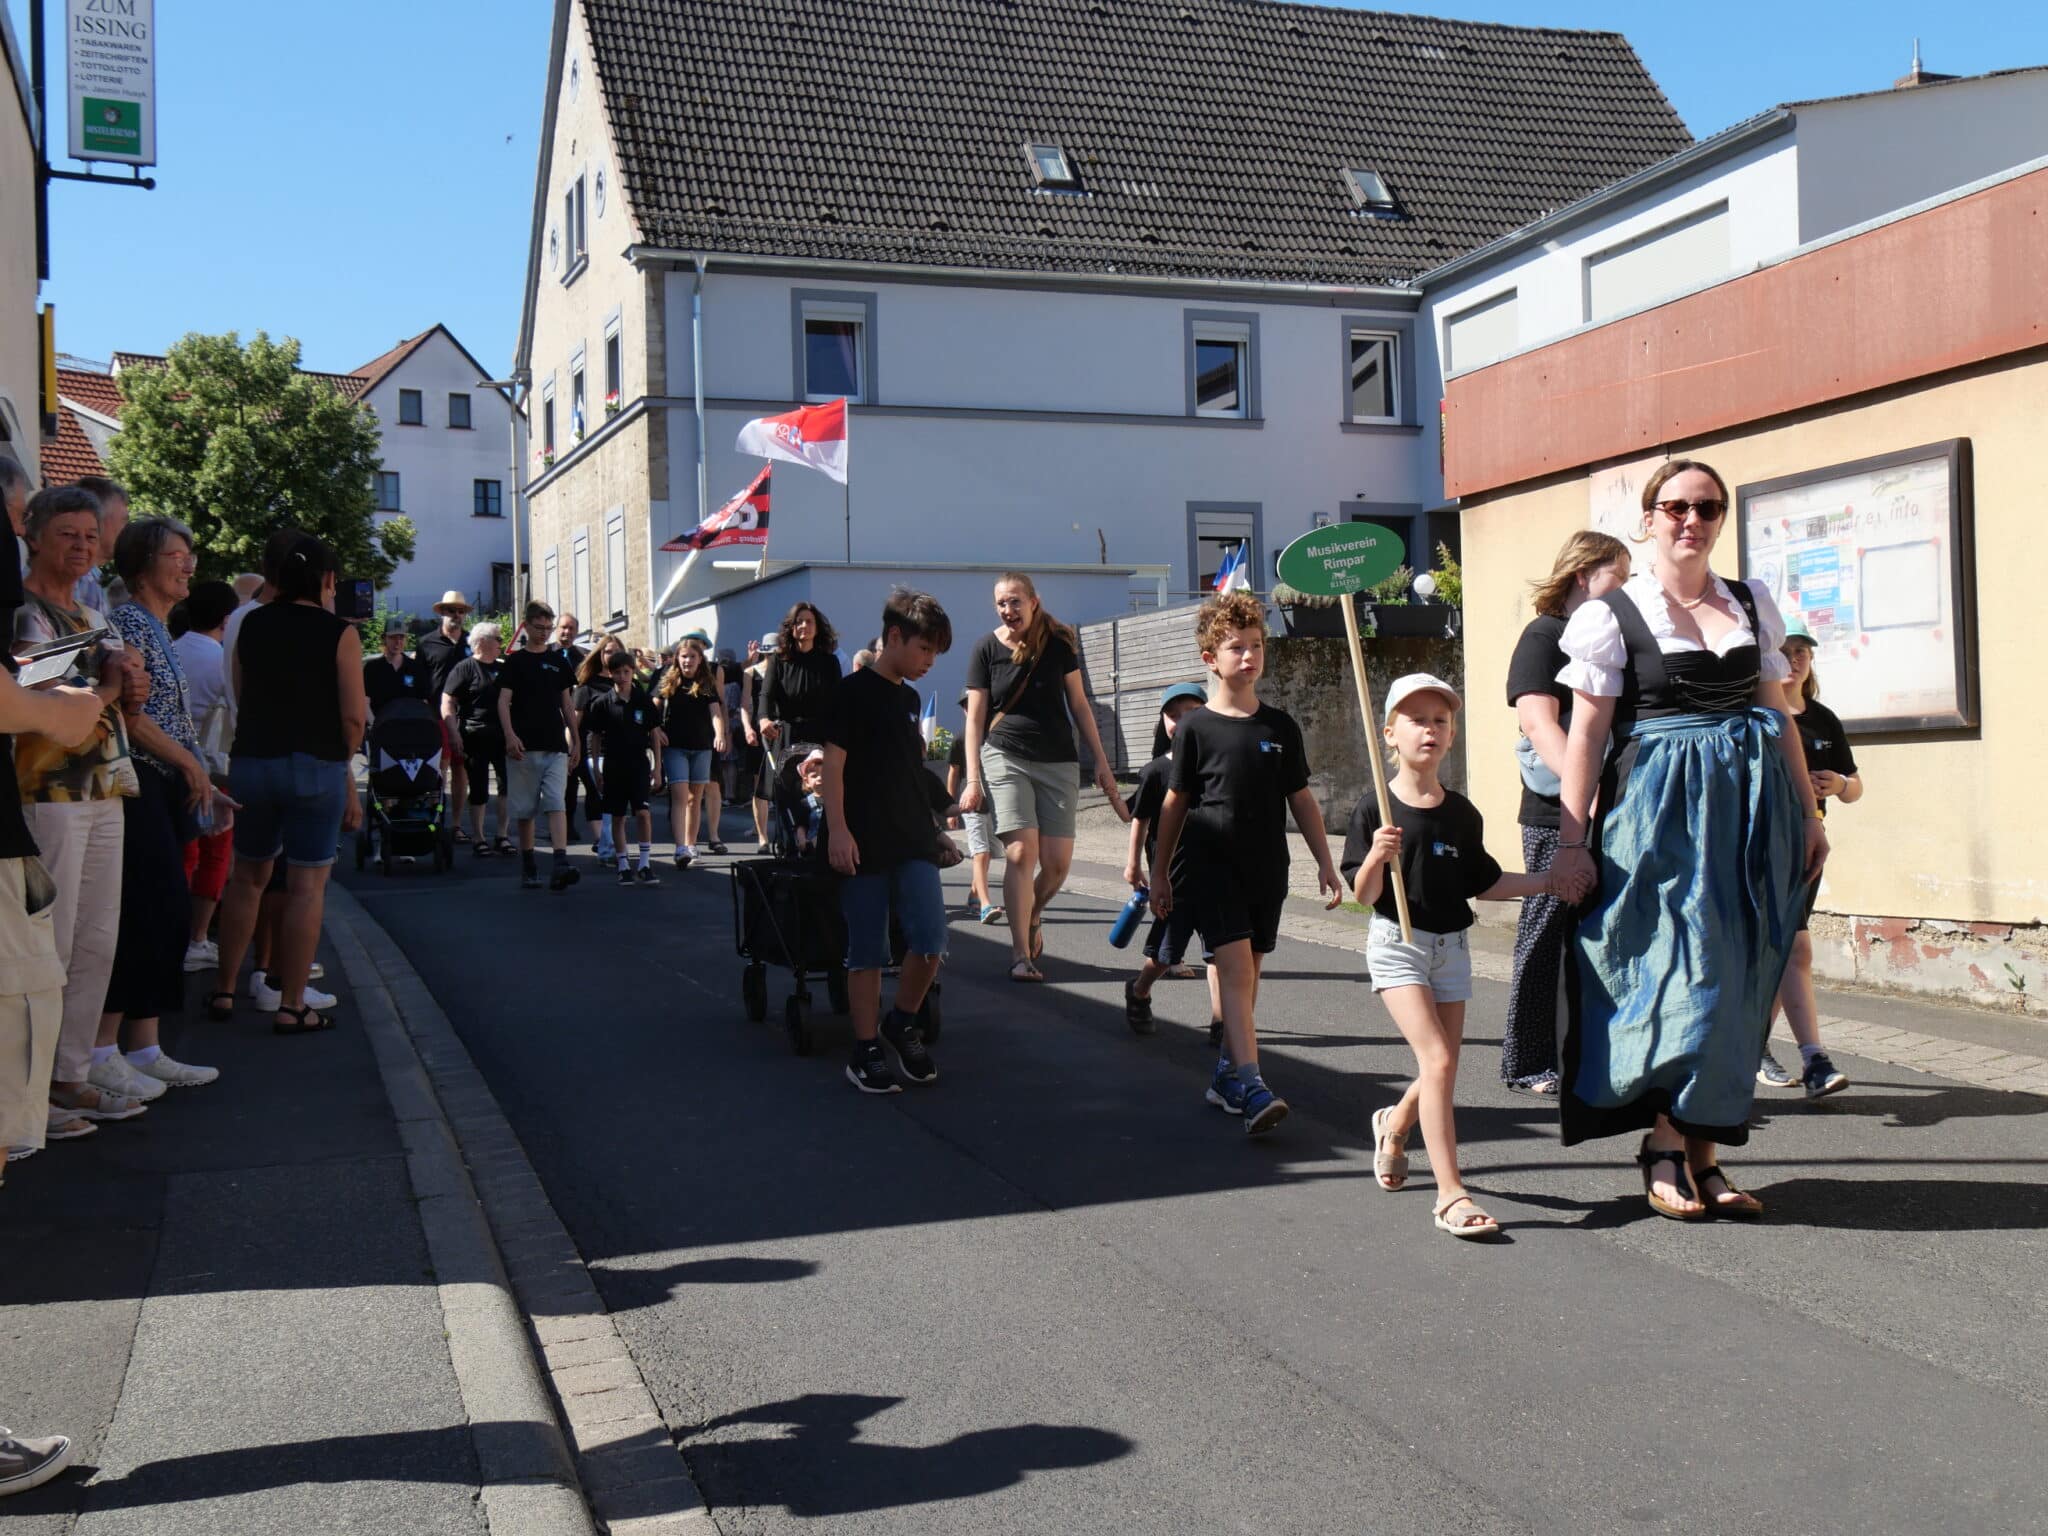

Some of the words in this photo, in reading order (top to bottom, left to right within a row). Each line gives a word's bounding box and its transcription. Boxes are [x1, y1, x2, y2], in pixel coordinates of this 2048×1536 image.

[86, 0, 135, 16] ZUM
[74, 15, 147, 40] ISSING
[80, 38, 142, 52] TABAKWAREN
[80, 50, 148, 65] ZEITSCHRIFTEN
[80, 73, 123, 85] LOTTERIE
[1307, 537, 1377, 558] Musikverein
[1323, 555, 1367, 571] Rimpar
